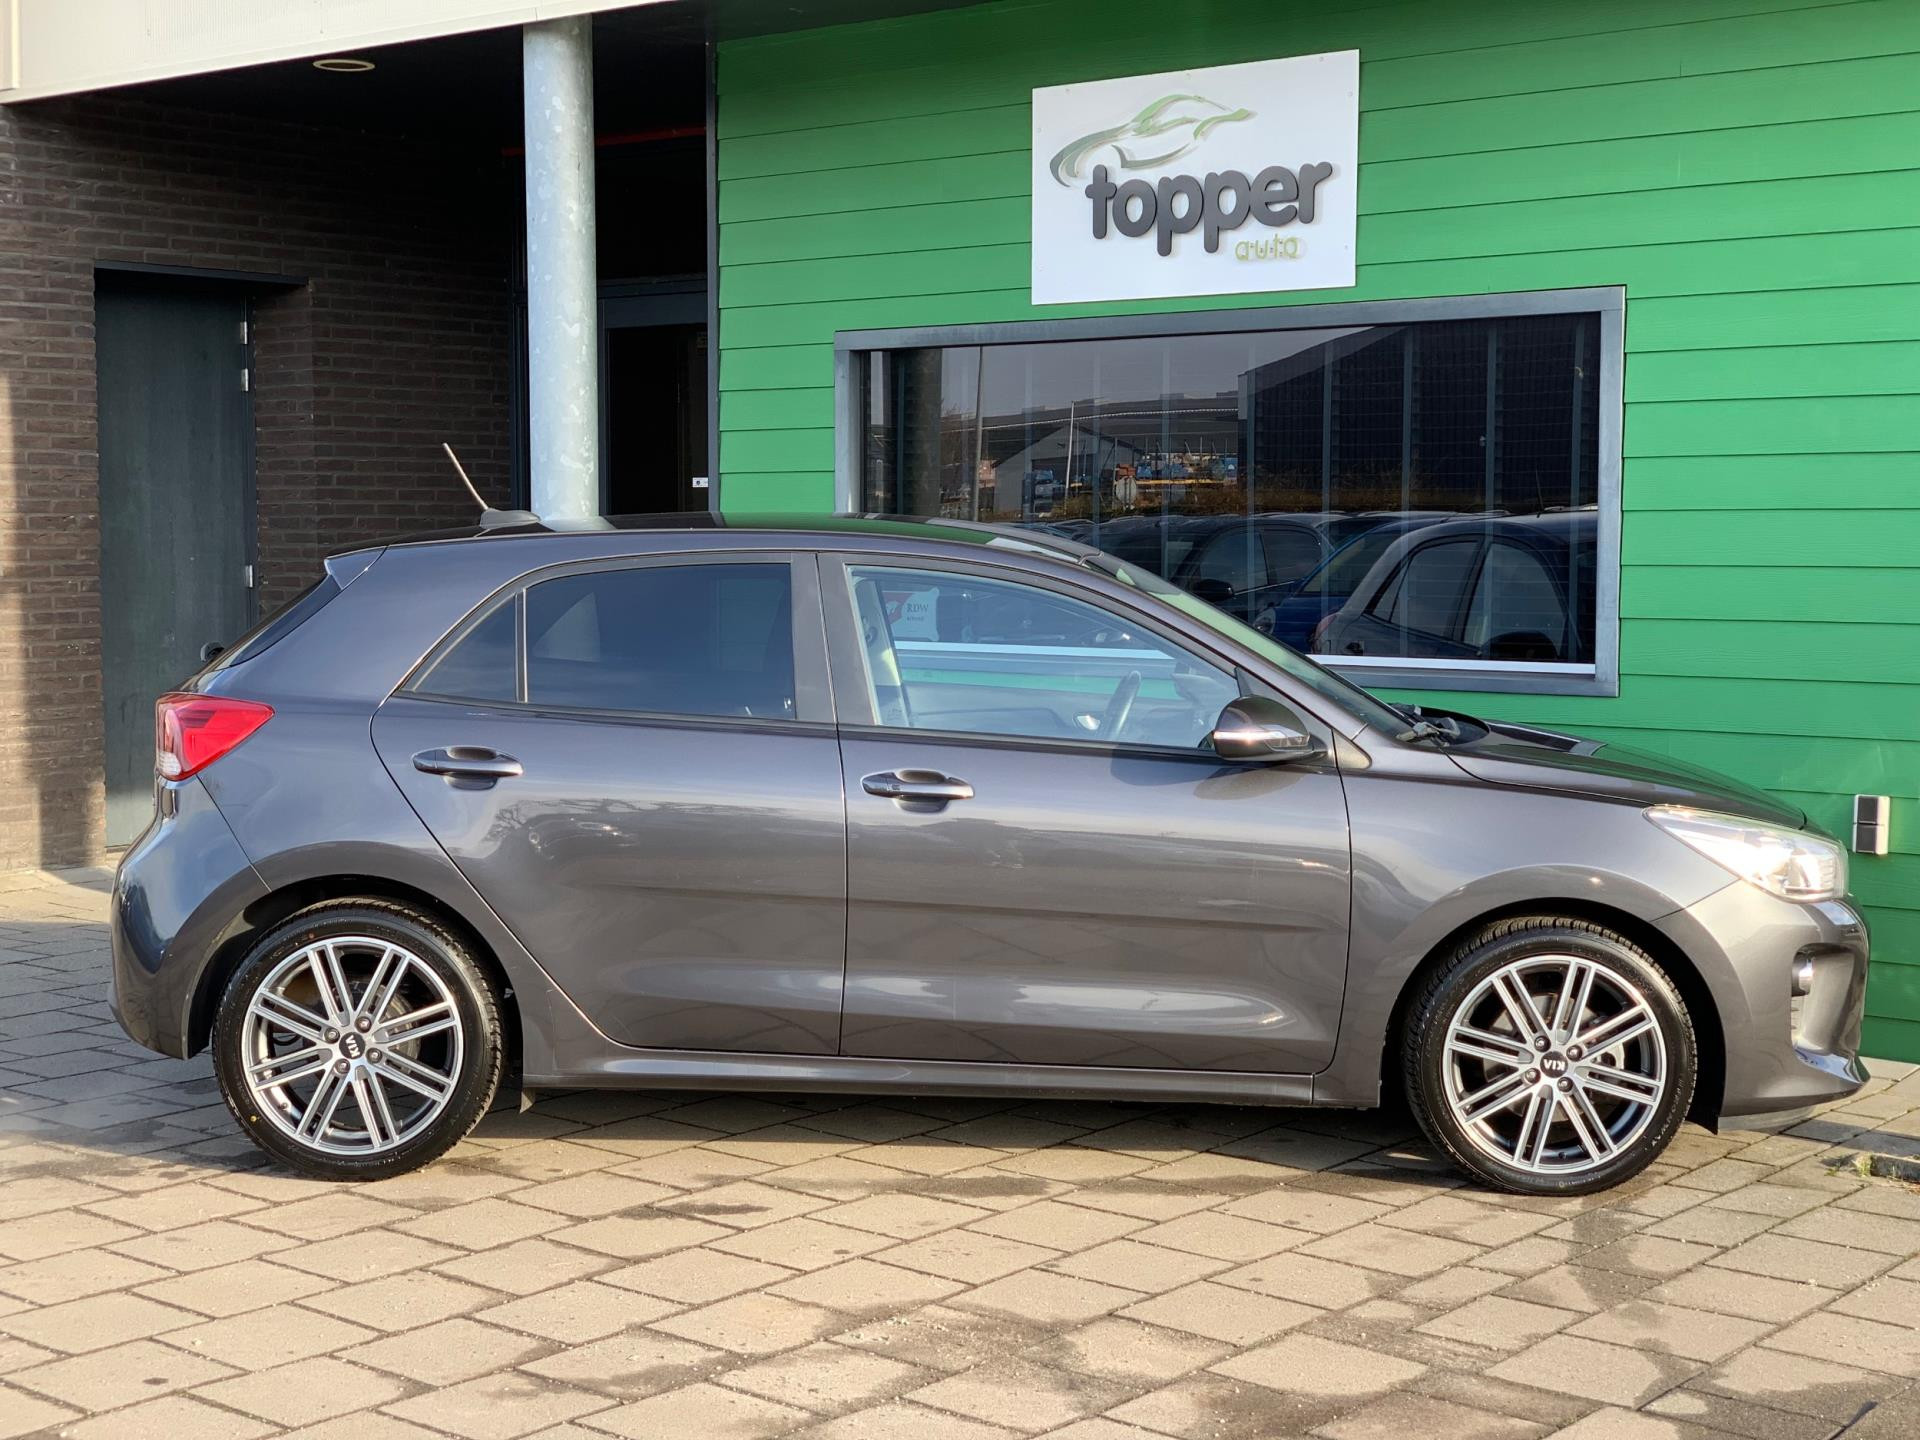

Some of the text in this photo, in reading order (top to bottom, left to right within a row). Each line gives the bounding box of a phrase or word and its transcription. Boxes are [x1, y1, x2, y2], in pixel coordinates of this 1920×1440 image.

[1085, 161, 1333, 257] topper
[1235, 233, 1299, 261] auto
[906, 603, 929, 613] RDW
[345, 1034, 361, 1058] KIA
[1543, 1058, 1566, 1071] KIA
